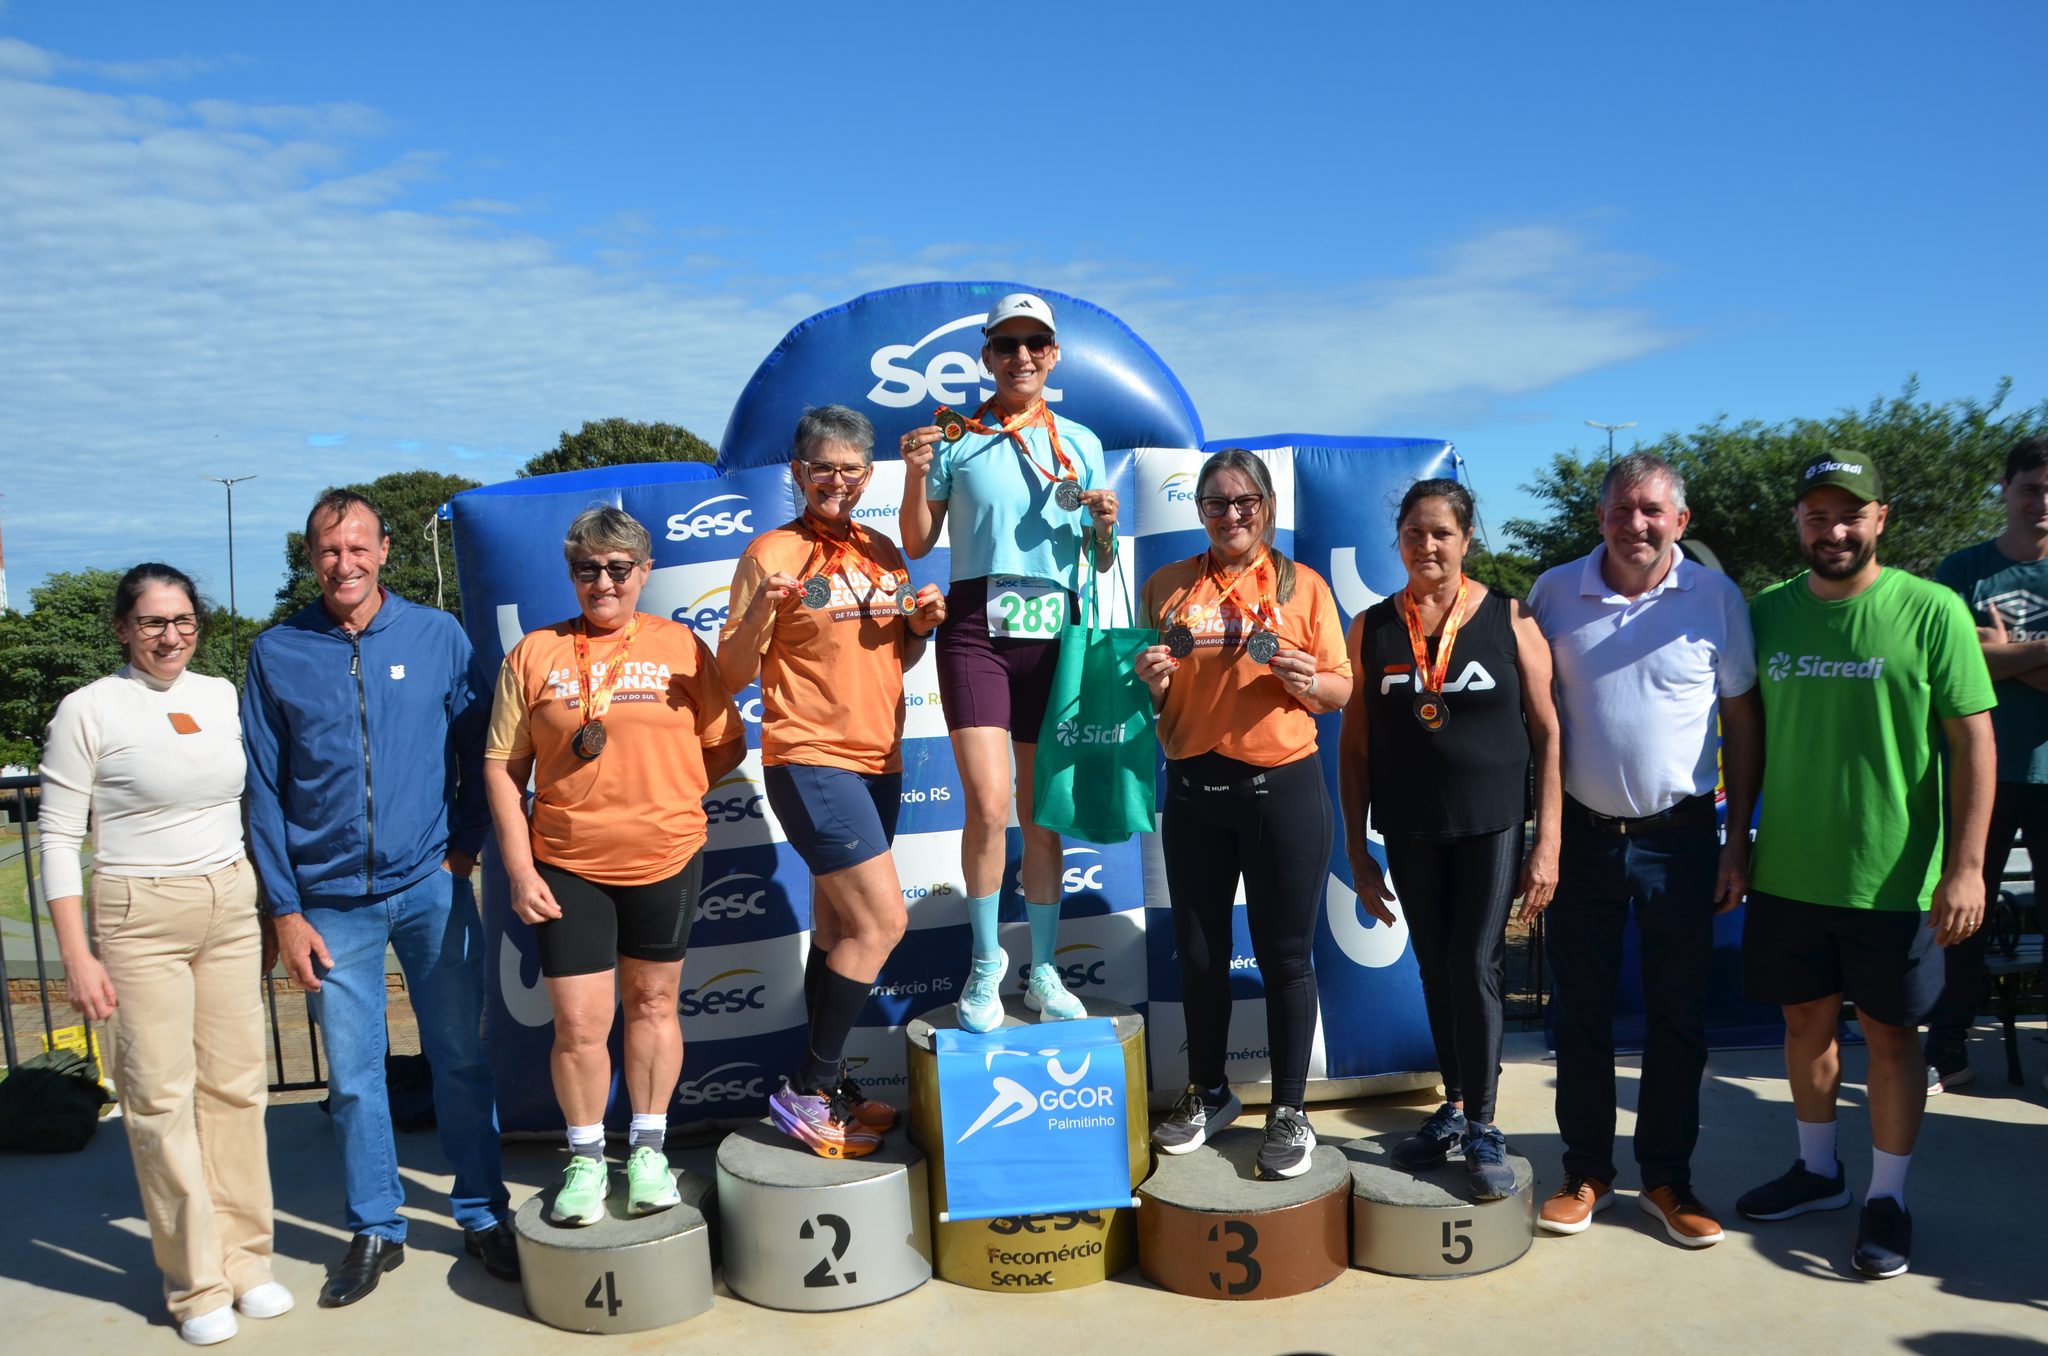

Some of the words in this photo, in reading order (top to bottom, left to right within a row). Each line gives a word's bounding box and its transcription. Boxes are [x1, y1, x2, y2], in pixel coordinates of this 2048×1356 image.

[1817, 460, 1862, 475] Sicredi
[1000, 595, 1061, 633] 283
[1795, 655, 1885, 680] Sicredi
[930, 787, 950, 801] RS
[932, 882, 951, 897] RS
[932, 977, 952, 991] RS
[1039, 1086, 1113, 1111] GCOR
[1048, 1115, 1115, 1131] Palmitinho
[800, 1214, 857, 1288] 2
[988, 1240, 1103, 1266] Fecomércio
[1441, 1219, 1473, 1265] 5
[1207, 1220, 1262, 1295] 3
[990, 1269, 1053, 1287] Senac
[585, 1271, 623, 1316] 4
